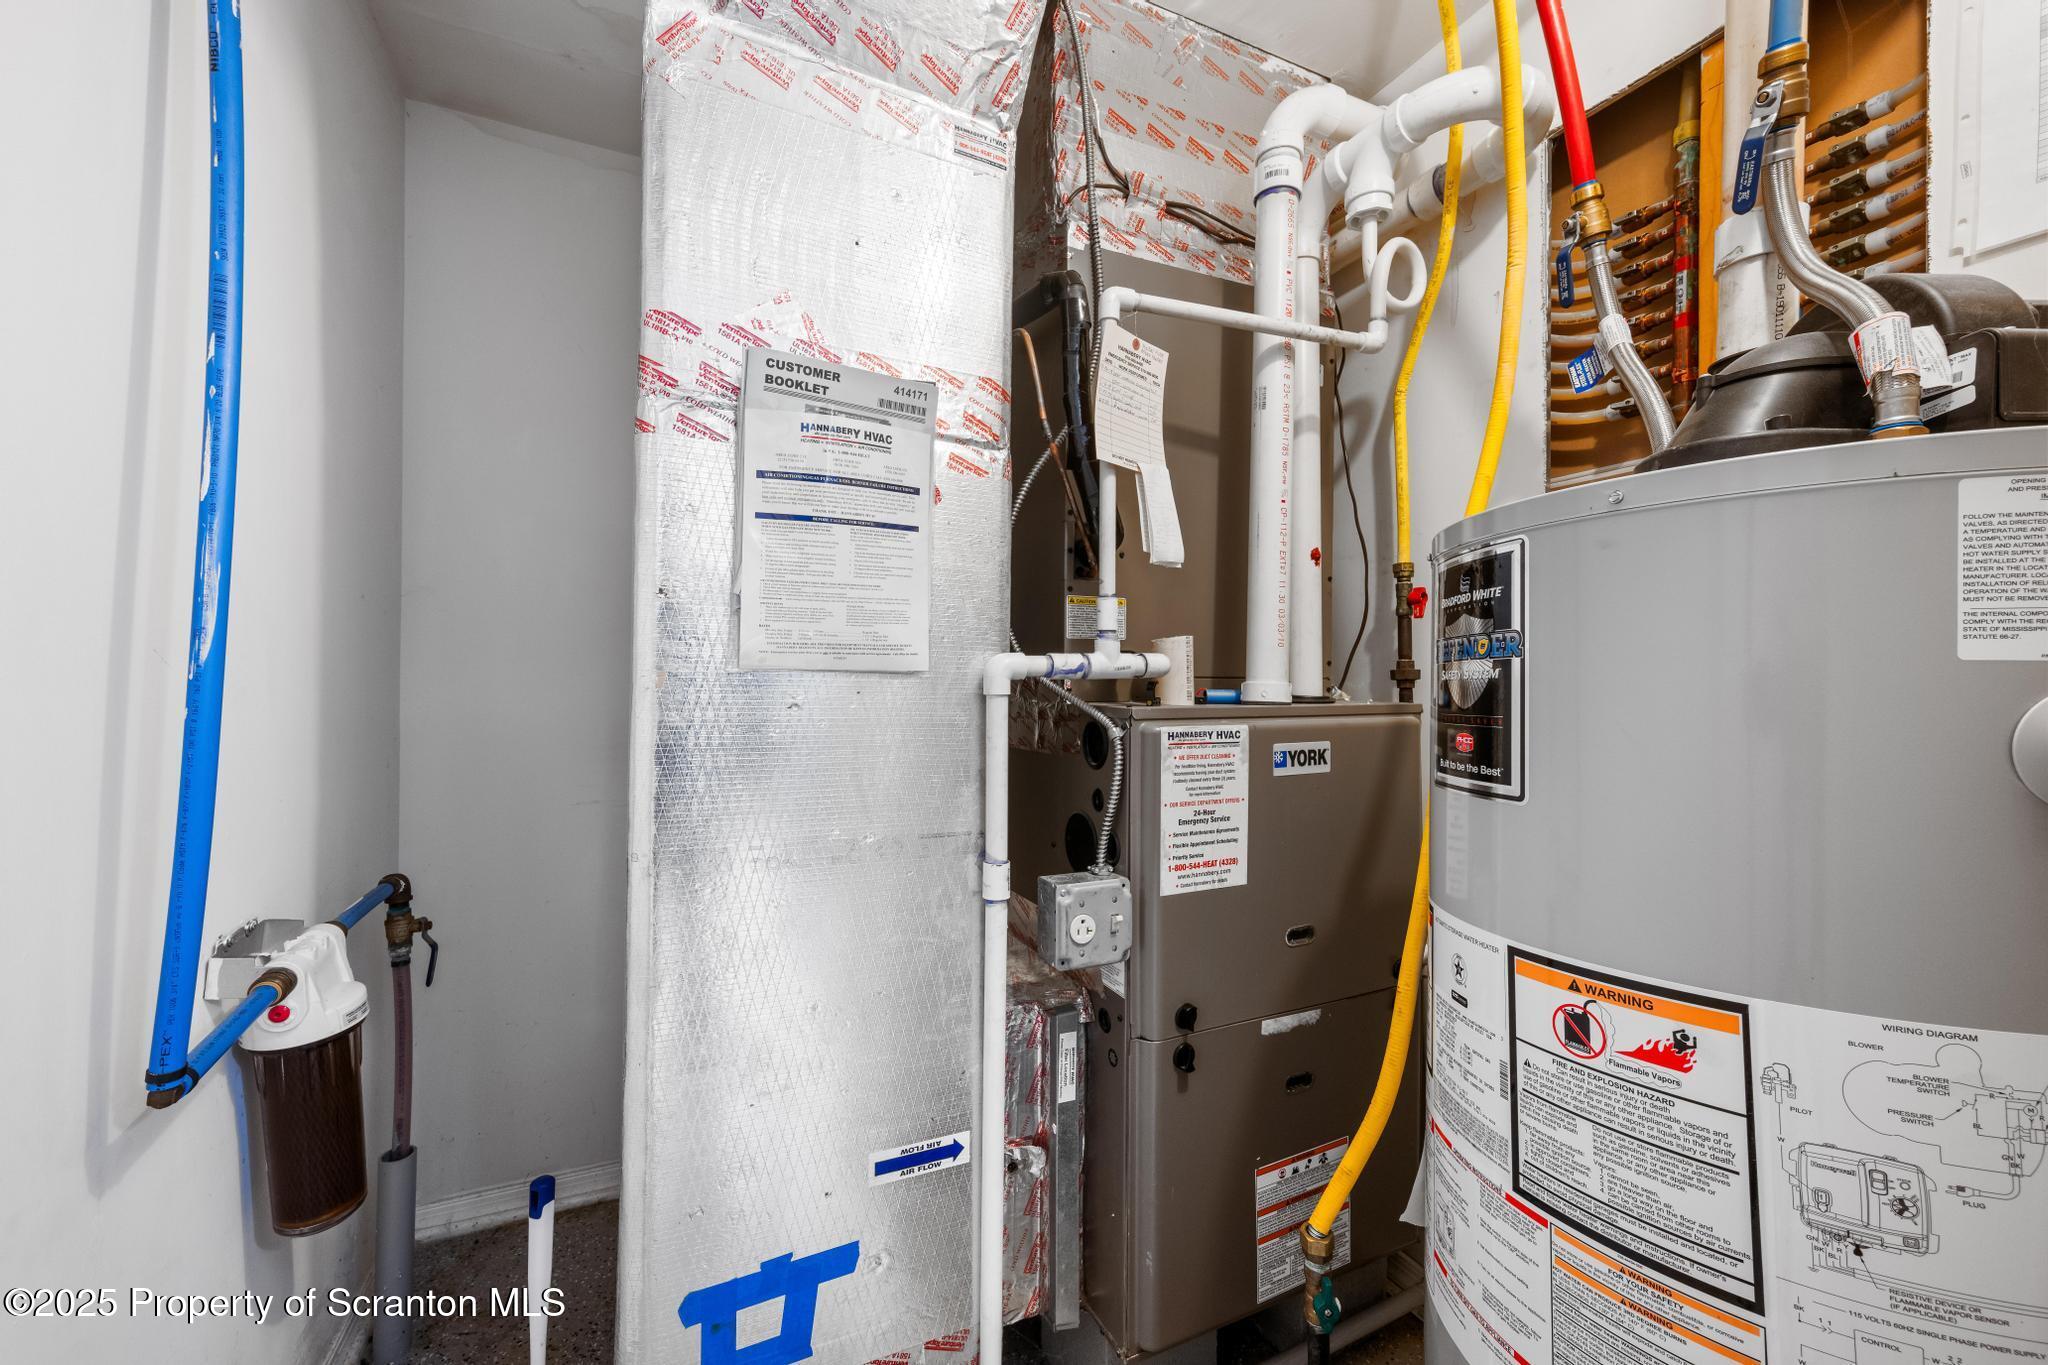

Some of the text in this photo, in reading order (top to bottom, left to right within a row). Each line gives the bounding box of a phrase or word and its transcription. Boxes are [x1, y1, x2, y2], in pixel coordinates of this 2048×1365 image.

[649, 308, 702, 337] entureTape
[765, 357, 841, 383] CUSTOMER
[764, 373, 830, 396] BOOKLET
[893, 386, 929, 402] 414171
[800, 422, 893, 445] HANNABERY HVAC
[1441, 592, 1471, 609] BRADFORD
[1472, 586, 1501, 601] WHITE
[1463, 668, 1499, 680] SYSTEM
[1168, 731, 1241, 740] HANNABERY HVAC
[1288, 749, 1328, 768] YORK
[1457, 761, 1465, 771] be
[1466, 764, 1478, 774] the
[1480, 765, 1501, 777] Best
[1179, 817, 1209, 826] Emergency
[1168, 858, 1239, 872] 1-800-544-HEAT (4328)
[1585, 984, 1654, 1010] WARNING
[1882, 1024, 1978, 1042] WIRING DIAGRAM
[159, 1034, 172, 1068] PEX
[1848, 1040, 1884, 1051] BLOWER
[1609, 1058, 1682, 1088] Flammable Vapors
[1912, 1074, 1951, 1084] BLOWER
[1553, 1058, 1675, 1106] FIRE AND EXPLOSION HAZARD
[1886, 1077, 1950, 1090] TEMPERATURE
[1917, 1087, 1950, 1096] SWITCH
[1649, 1101, 1670, 1113] death
[1790, 1107, 1813, 1116] PILOT
[1888, 1109, 1935, 1120] PRESSURE
[1622, 1099, 1729, 1139] other flammable vapors and
[1901, 1116, 1934, 1127] SWITCH
[900, 1140, 942, 1156] AIR FLOW
[900, 1161, 942, 1177] AIR FLOW
[1963, 1201, 1986, 1209] PLUG
[1608, 1269, 1684, 1310] FOR YOUR SAFETY
[1628, 1269, 1674, 1298] WARNING
[1889, 1288, 1983, 1314] RESISTIVE DEVICE OR
[1629, 1300, 1675, 1331] WARNING
[1890, 1296, 2010, 1327] FLAMMABLE VAPOR SENSOR
[1849, 1310, 1863, 1320] 115
[1864, 1314, 1892, 1326] VOLTS
[1916, 1325, 1947, 1340] SINGLE
[1949, 1333, 1978, 1347] PHASE
[1980, 1341, 2012, 1354] POWER
[2014, 1348, 2047, 1359] SUPPLY
[1861, 1337, 1902, 1352] CONTROL
